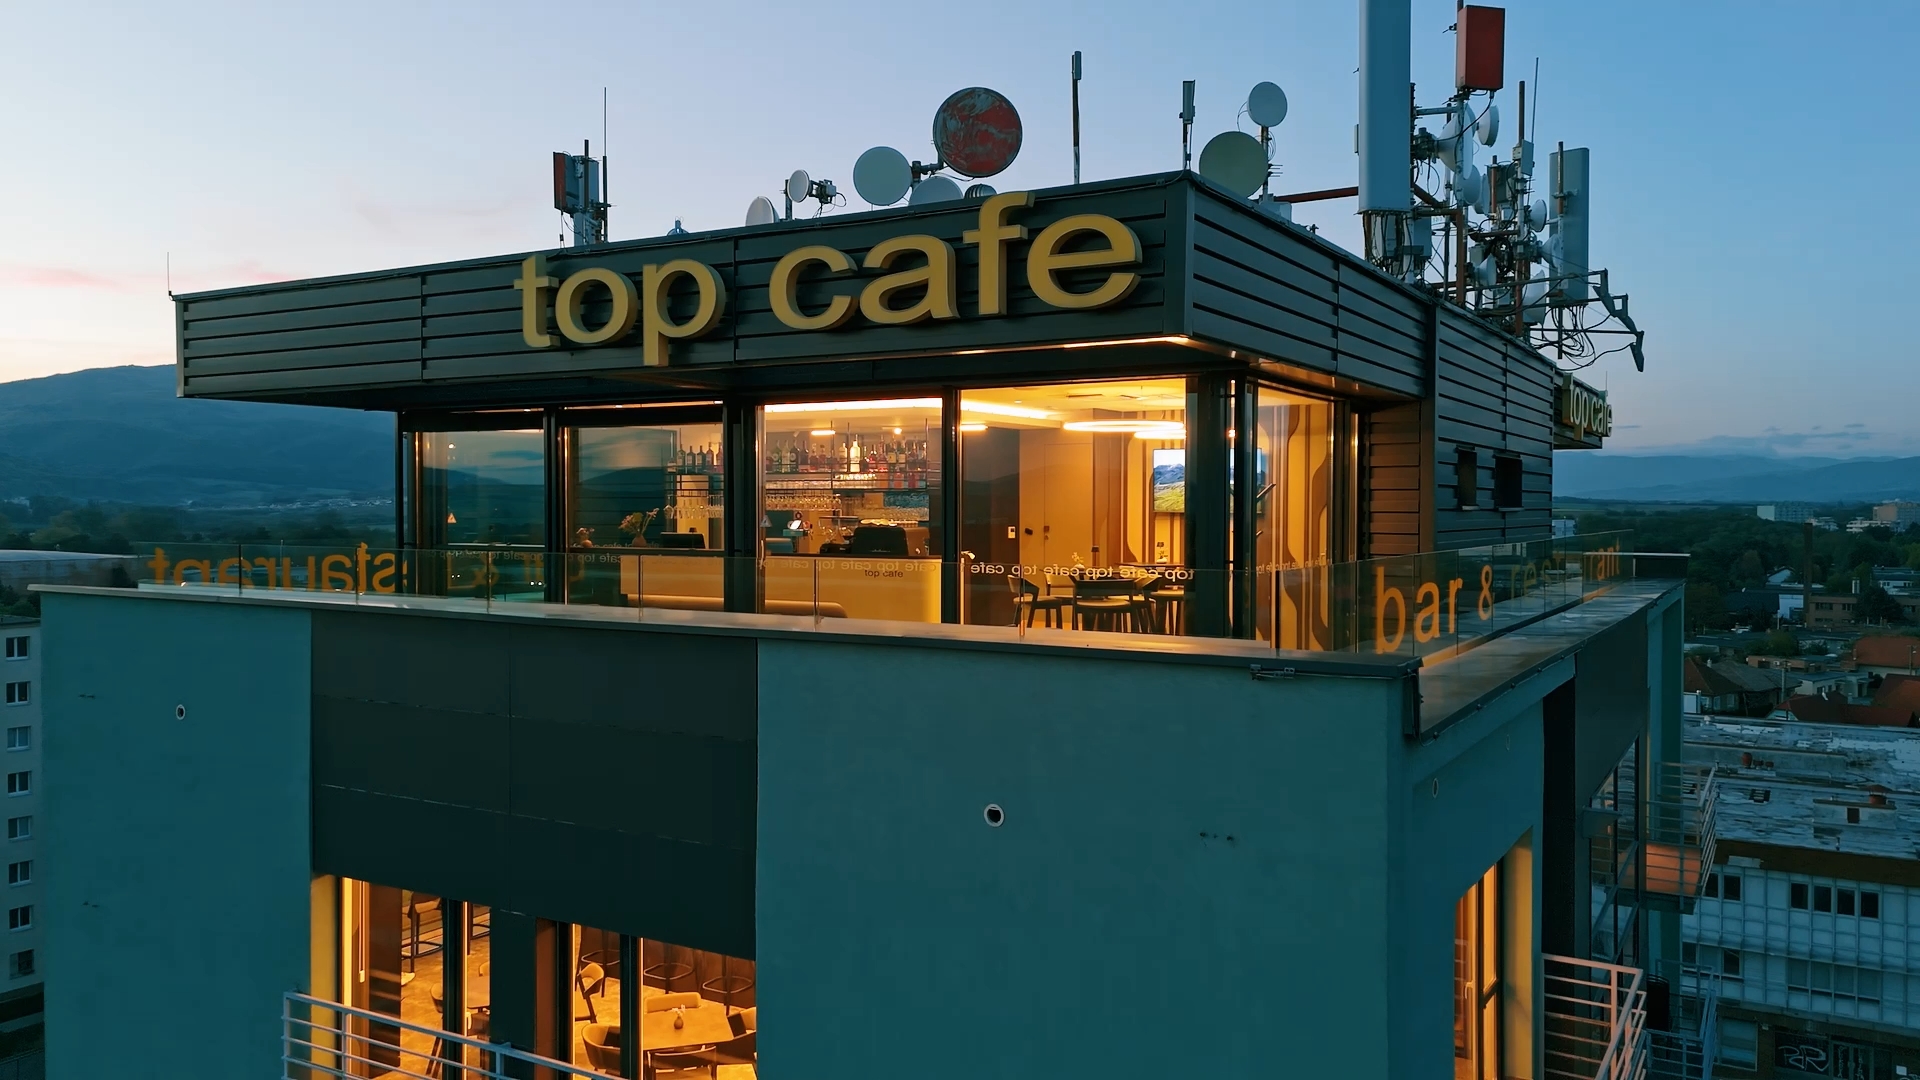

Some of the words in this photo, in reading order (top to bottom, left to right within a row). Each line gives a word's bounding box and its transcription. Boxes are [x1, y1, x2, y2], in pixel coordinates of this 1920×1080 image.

[514, 255, 726, 367] top
[769, 191, 1143, 330] cafe
[1566, 372, 1588, 440] top
[1591, 391, 1612, 437] cafe
[864, 569, 880, 578] top
[883, 569, 904, 578] cafe
[1376, 566, 1463, 654] bar
[1478, 564, 1494, 621] &
